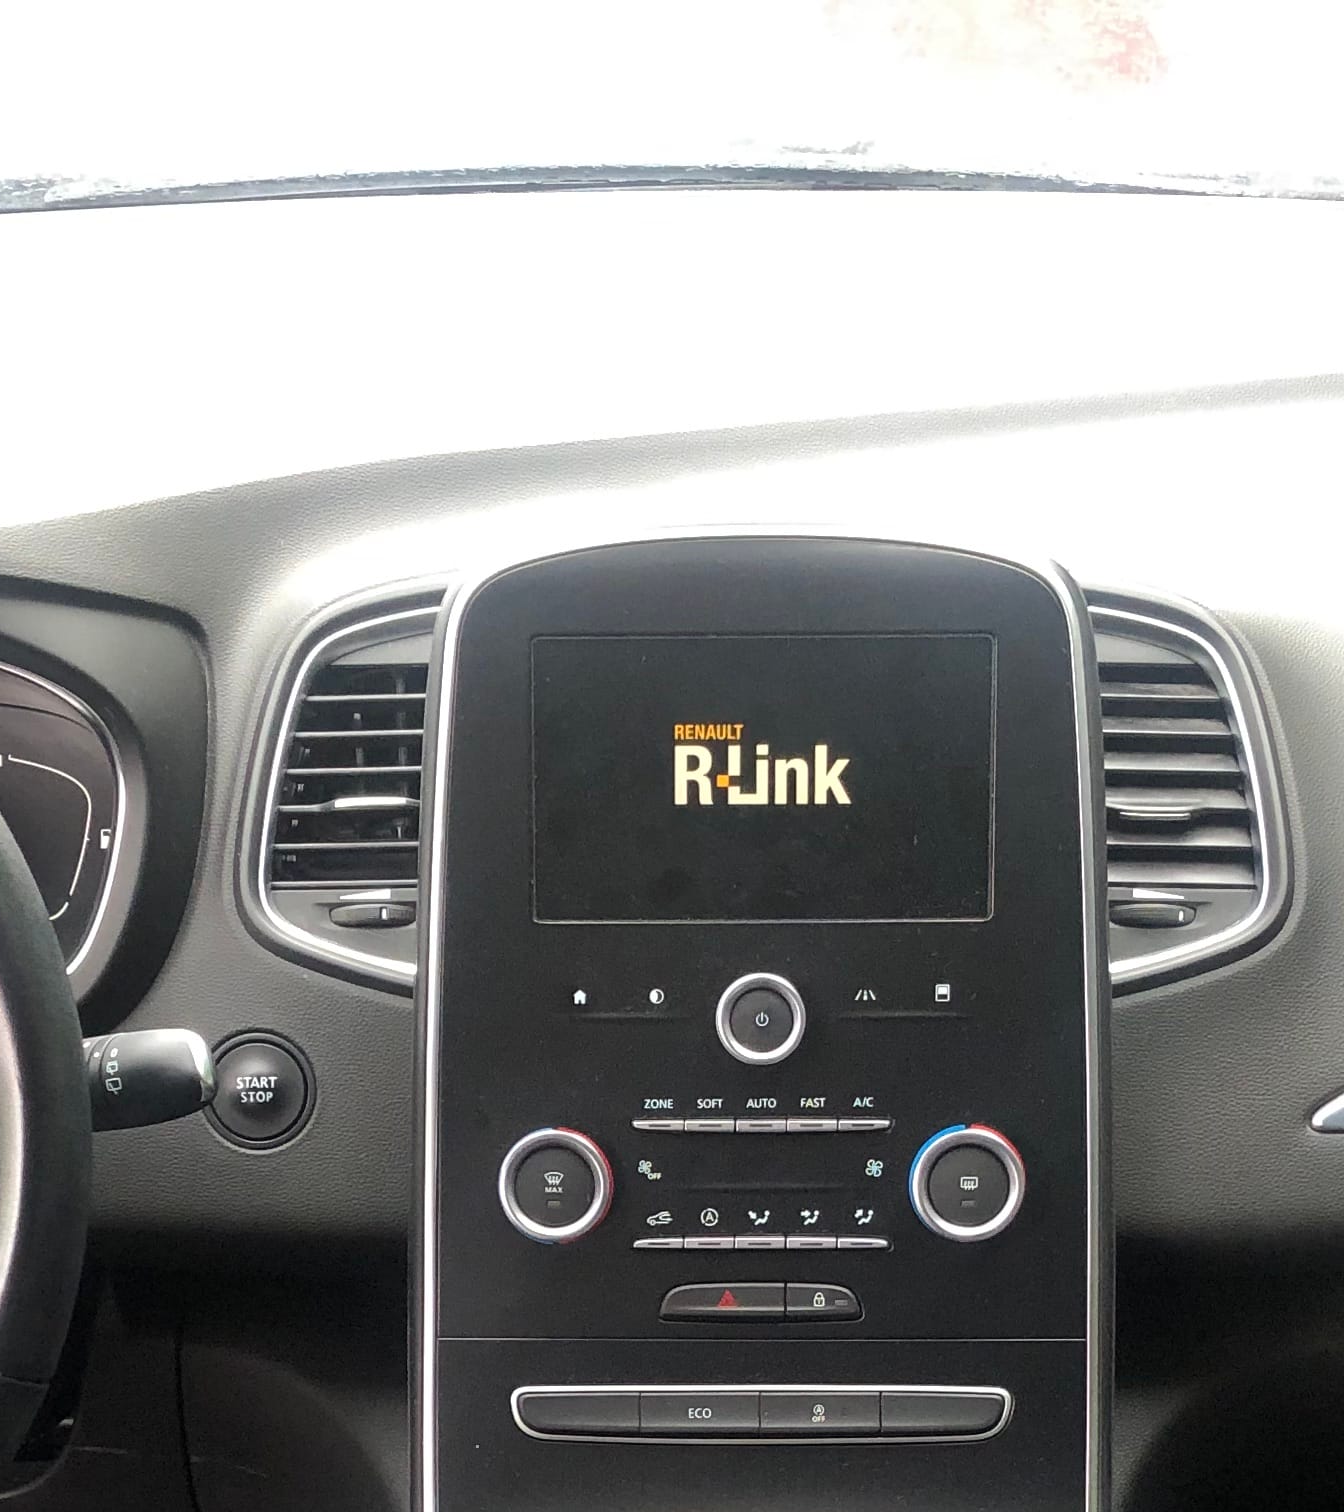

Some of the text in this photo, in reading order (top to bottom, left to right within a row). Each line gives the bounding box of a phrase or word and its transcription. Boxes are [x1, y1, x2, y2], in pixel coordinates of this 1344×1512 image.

[674, 724, 744, 740] RENAULT
[236, 1076, 278, 1090] START
[240, 1091, 274, 1103] STOP
[800, 1097, 826, 1108] FAST
[853, 1096, 875, 1108] A/C
[643, 1098, 674, 1110] ZONE
[697, 1098, 723, 1109] SOFT
[746, 1098, 777, 1109] AUTO
[647, 1172, 662, 1181] OFF
[688, 1407, 712, 1419] ECO
[811, 1415, 826, 1423] OFF
